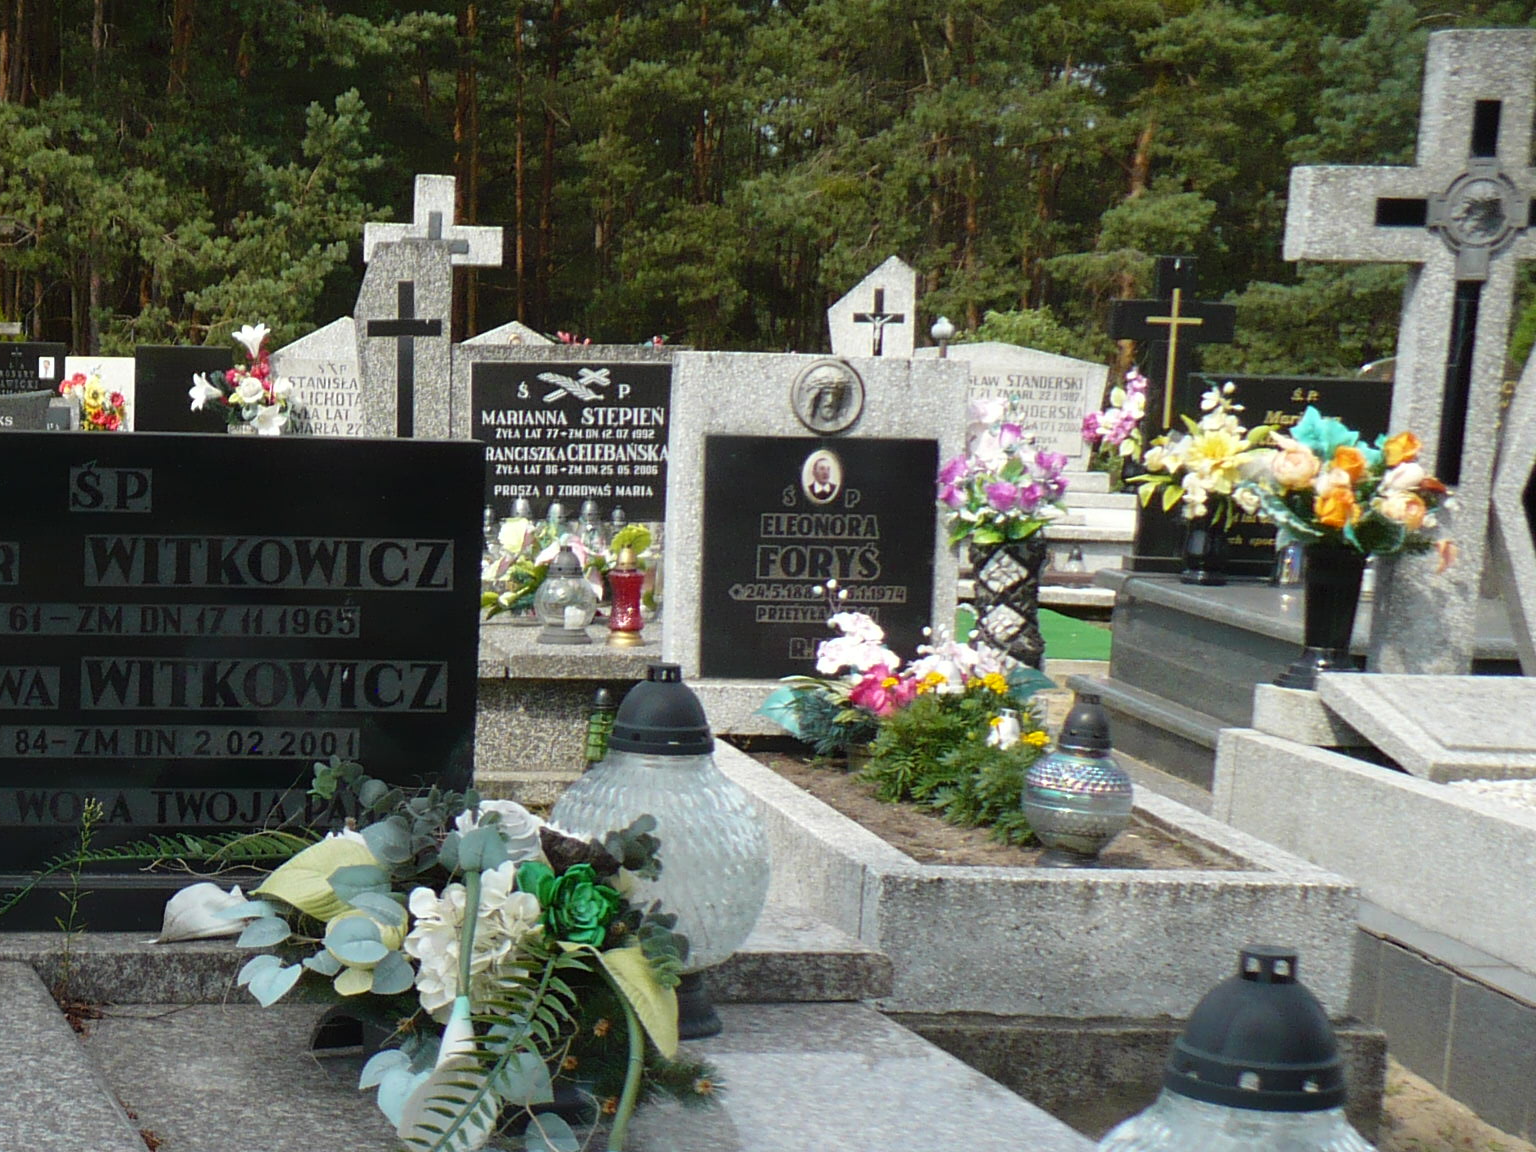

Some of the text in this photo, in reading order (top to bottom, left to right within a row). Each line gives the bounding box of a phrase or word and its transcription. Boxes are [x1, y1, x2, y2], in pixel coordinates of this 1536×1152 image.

[288, 375, 358, 390] STANISŁA
[1007, 374, 1083, 390] STANDERSKI
[326, 407, 351, 421] LAT
[482, 406, 665, 427] MARIANNA STĘPIEŃ
[525, 429, 542, 439] LAT
[484, 447, 566, 462] RANCISZKA
[524, 465, 541, 475] LAT
[494, 484, 539, 498] PROSZĄ
[558, 482, 612, 497] ZDROWAŚ
[615, 485, 654, 497] MARIA
[762, 513, 880, 539] ELEONORA
[88, 536, 449, 589] WITKOWICZ
[757, 542, 882, 581] FORYŚ
[84, 658, 444, 710] WITKOWICZ
[14, 789, 133, 826] WOA
[151, 790, 288, 826] TWOJA
